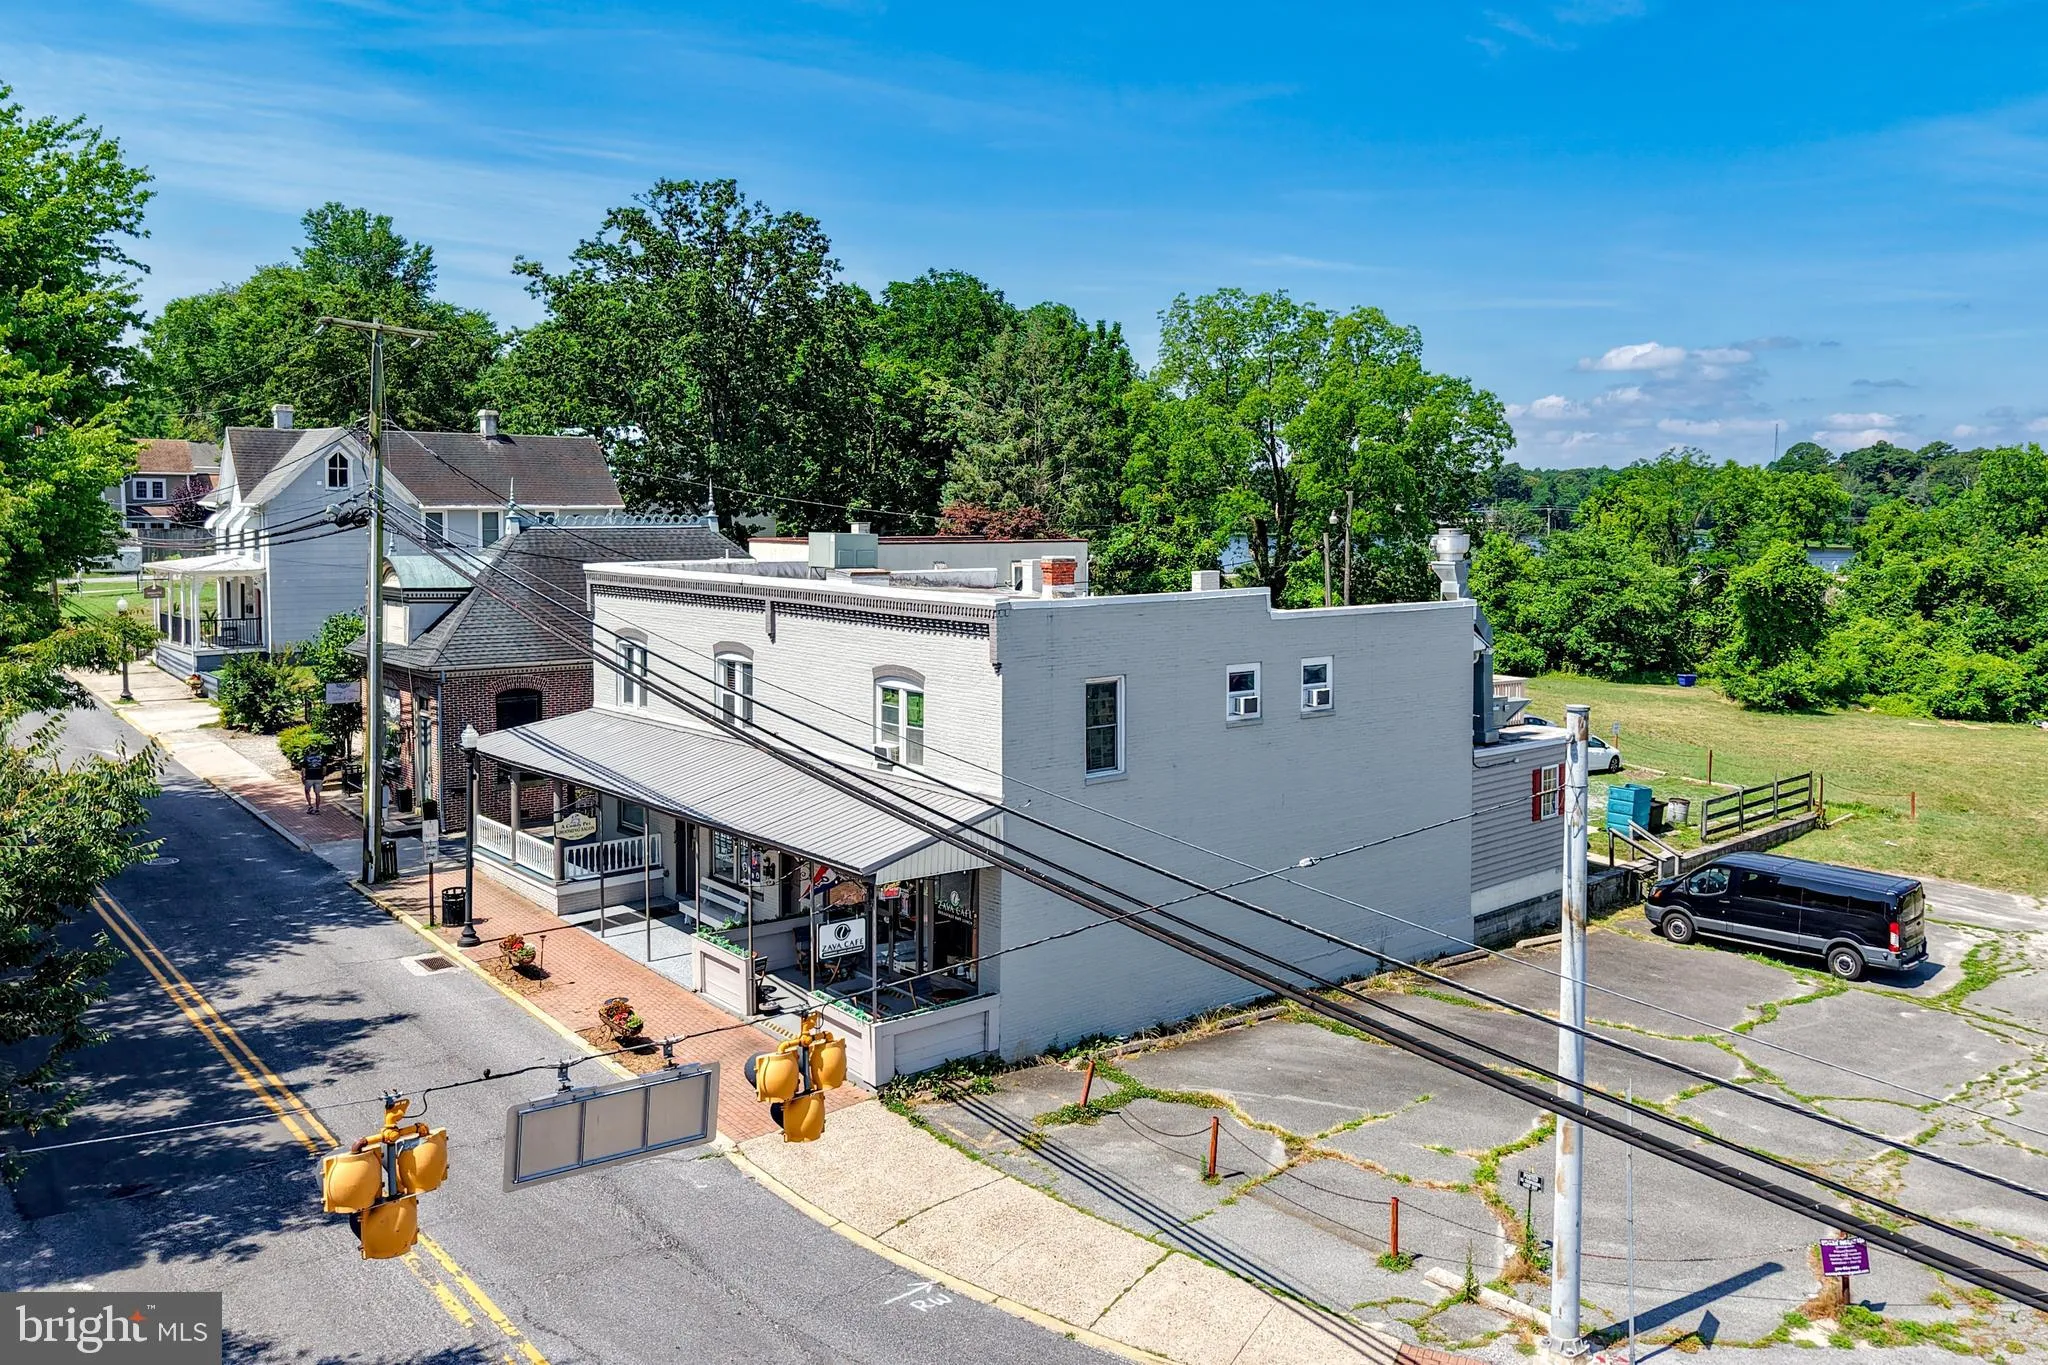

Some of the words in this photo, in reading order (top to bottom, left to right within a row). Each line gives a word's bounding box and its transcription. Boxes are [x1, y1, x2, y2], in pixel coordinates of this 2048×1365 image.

[938, 900, 954, 914] ZAVA
[822, 943, 842, 952] ZAVA
[844, 937, 864, 947] CAFE
